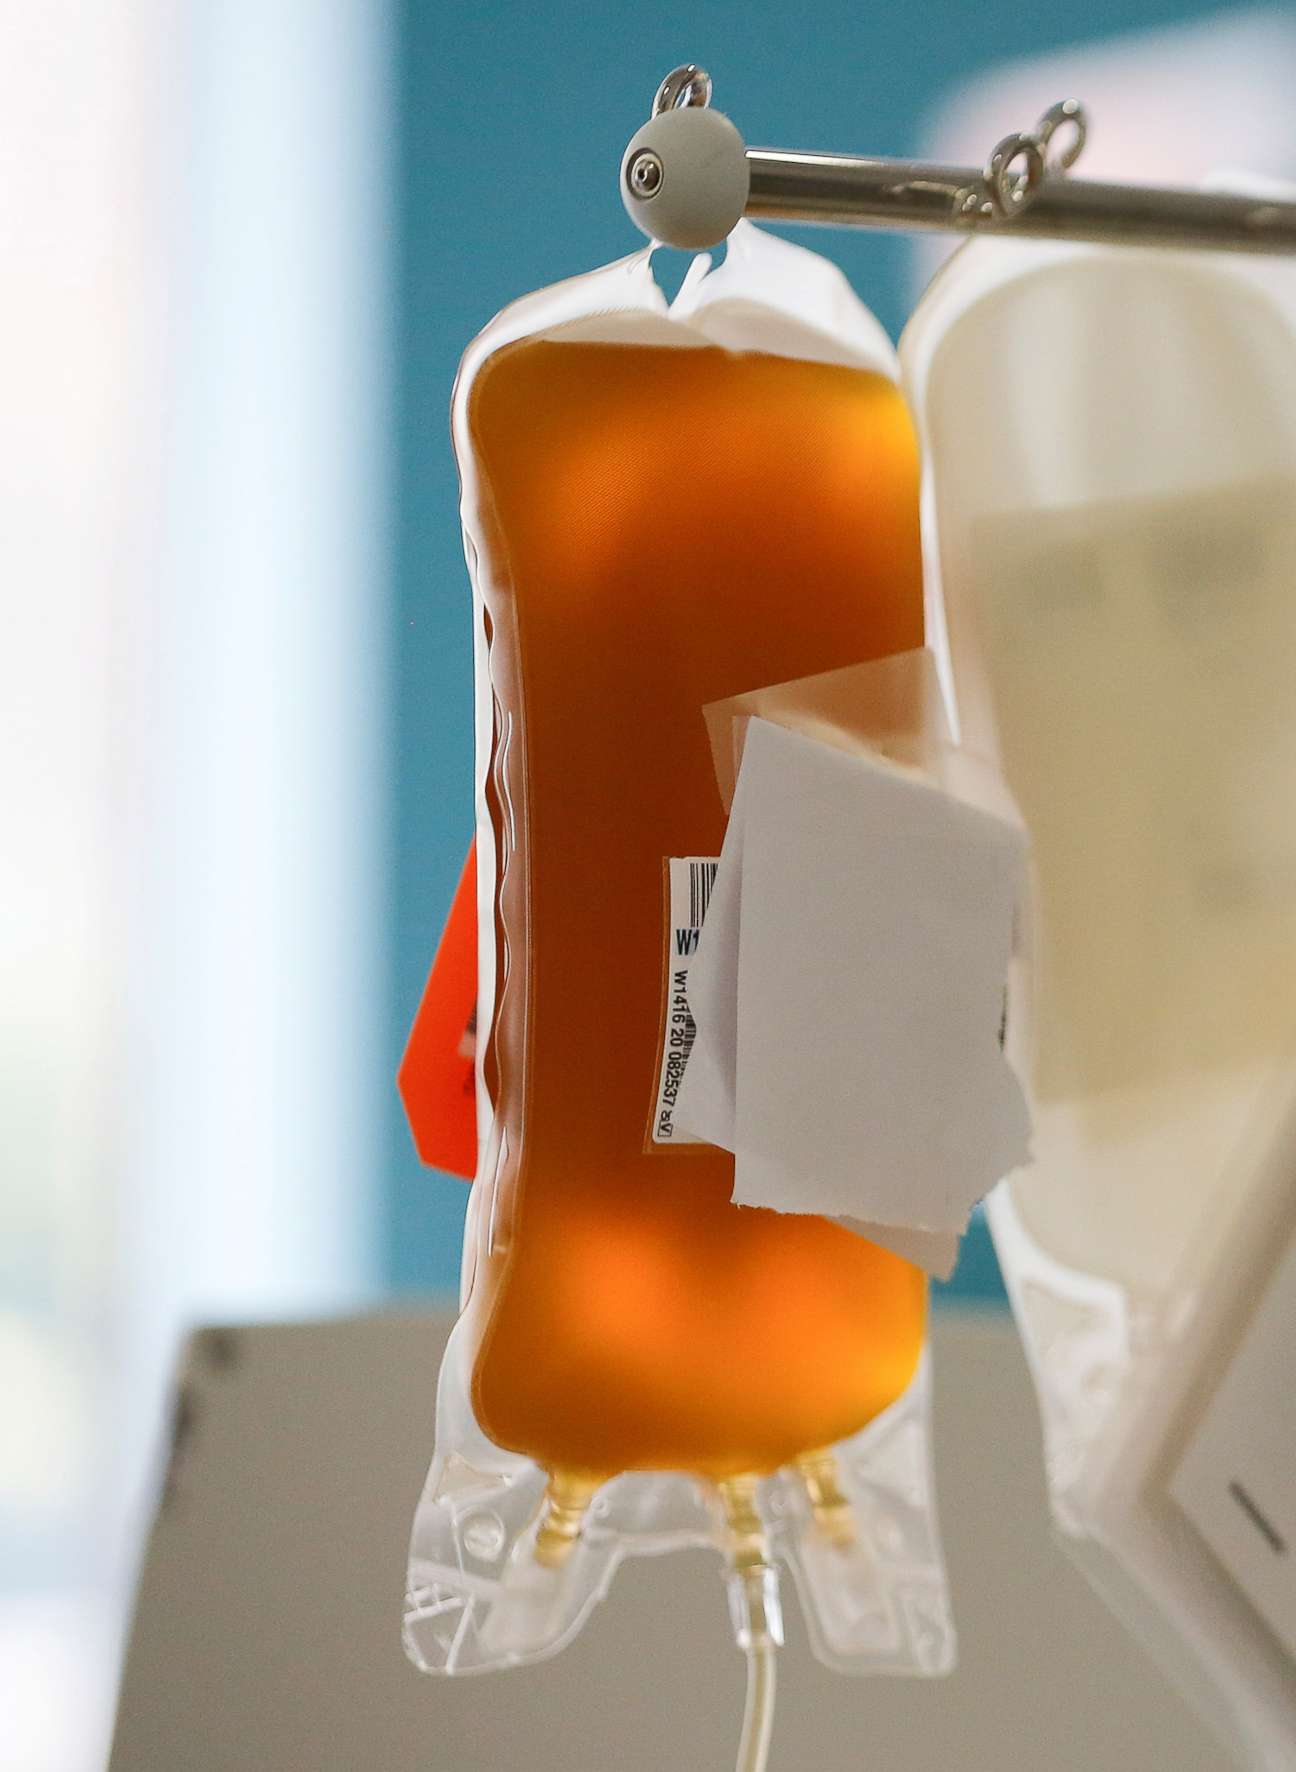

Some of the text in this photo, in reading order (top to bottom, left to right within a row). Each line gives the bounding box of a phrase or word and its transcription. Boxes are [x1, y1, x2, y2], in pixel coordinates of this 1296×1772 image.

[676, 928, 699, 955] W1
[672, 970, 688, 1023] W1416
[670, 1028, 684, 1047] 20
[662, 1051, 682, 1106] 082537
